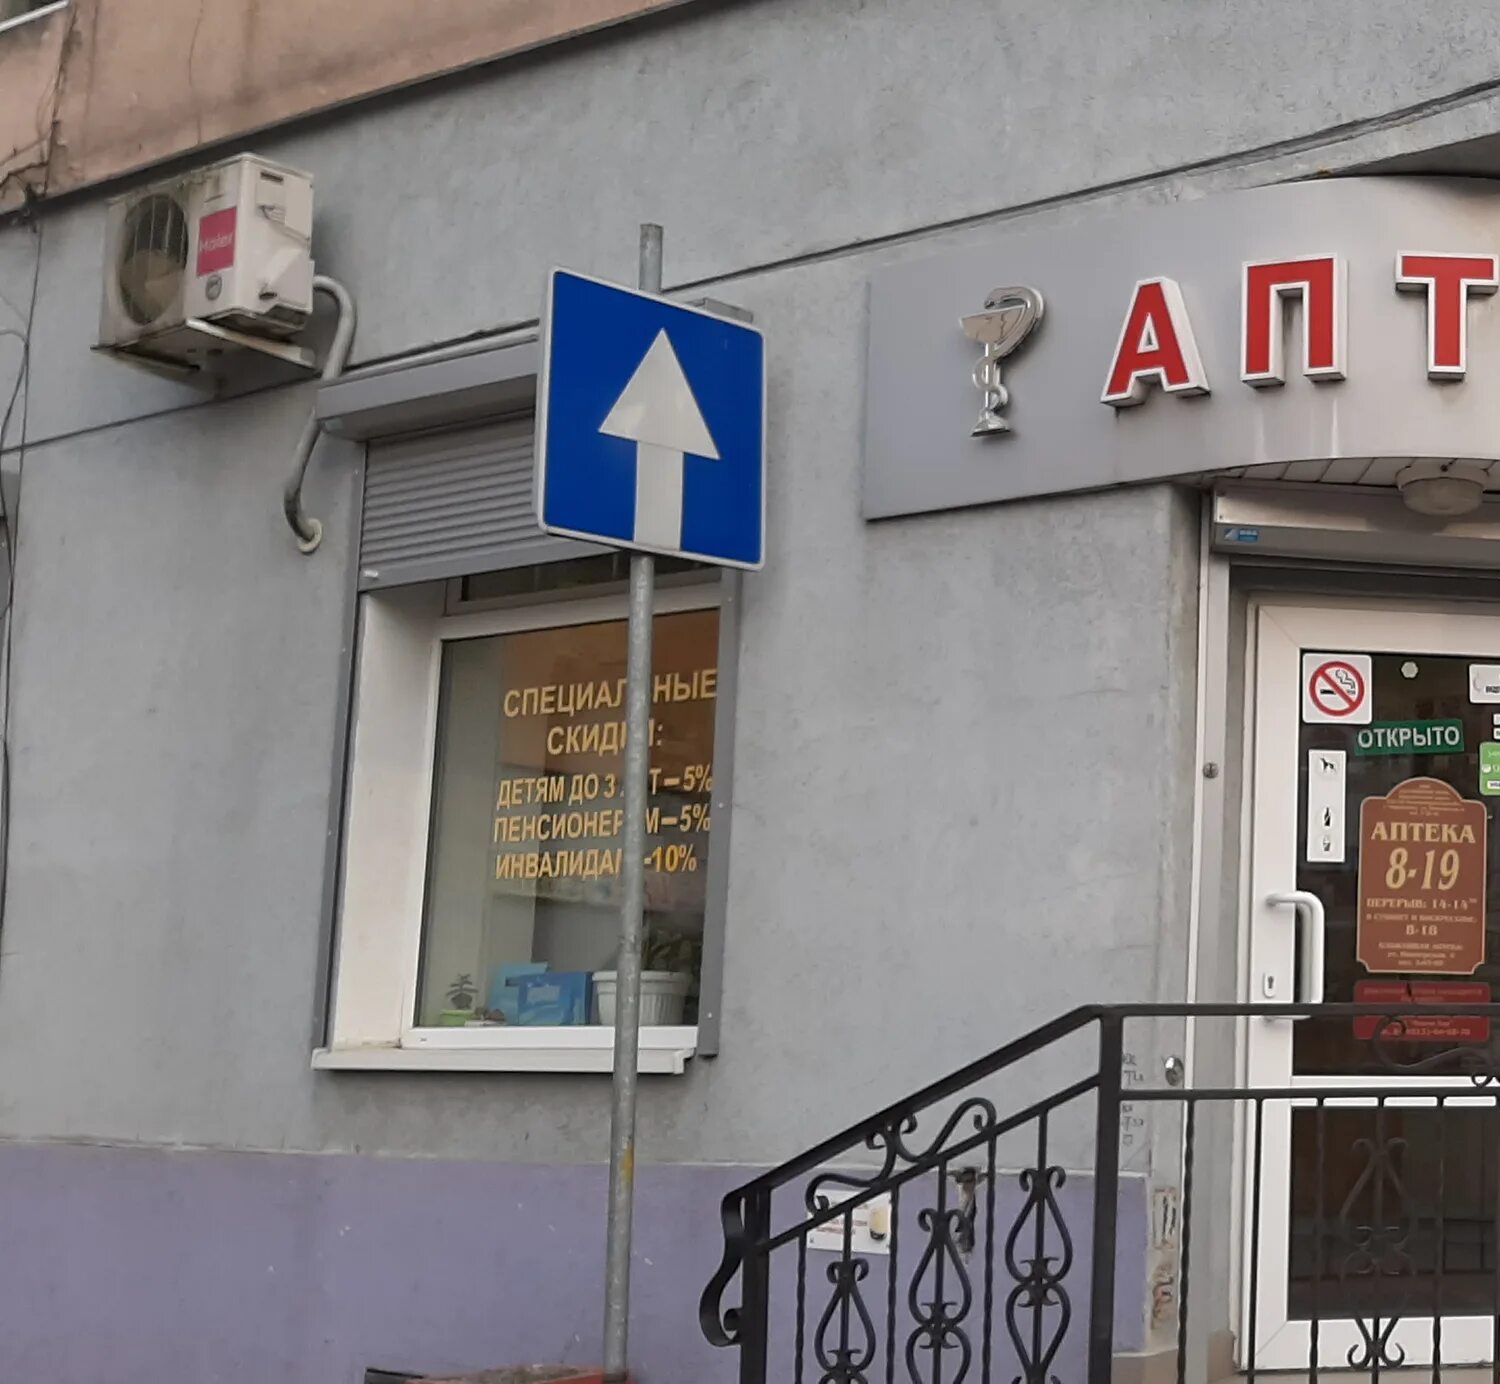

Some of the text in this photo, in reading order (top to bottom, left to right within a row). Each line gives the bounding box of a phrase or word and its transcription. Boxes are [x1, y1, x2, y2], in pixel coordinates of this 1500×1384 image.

[503, 668, 717, 717] СПЕЦИАЛНЫЕ
[1357, 726, 1460, 748] ОТКРЫТО
[496, 775, 564, 811] ДЕТЯМ
[568, 774, 599, 806] ДО
[603, 773, 616, 799] 3
[1370, 821, 1476, 844] АПТЕКА
[1385, 847, 1460, 890] 8-19
